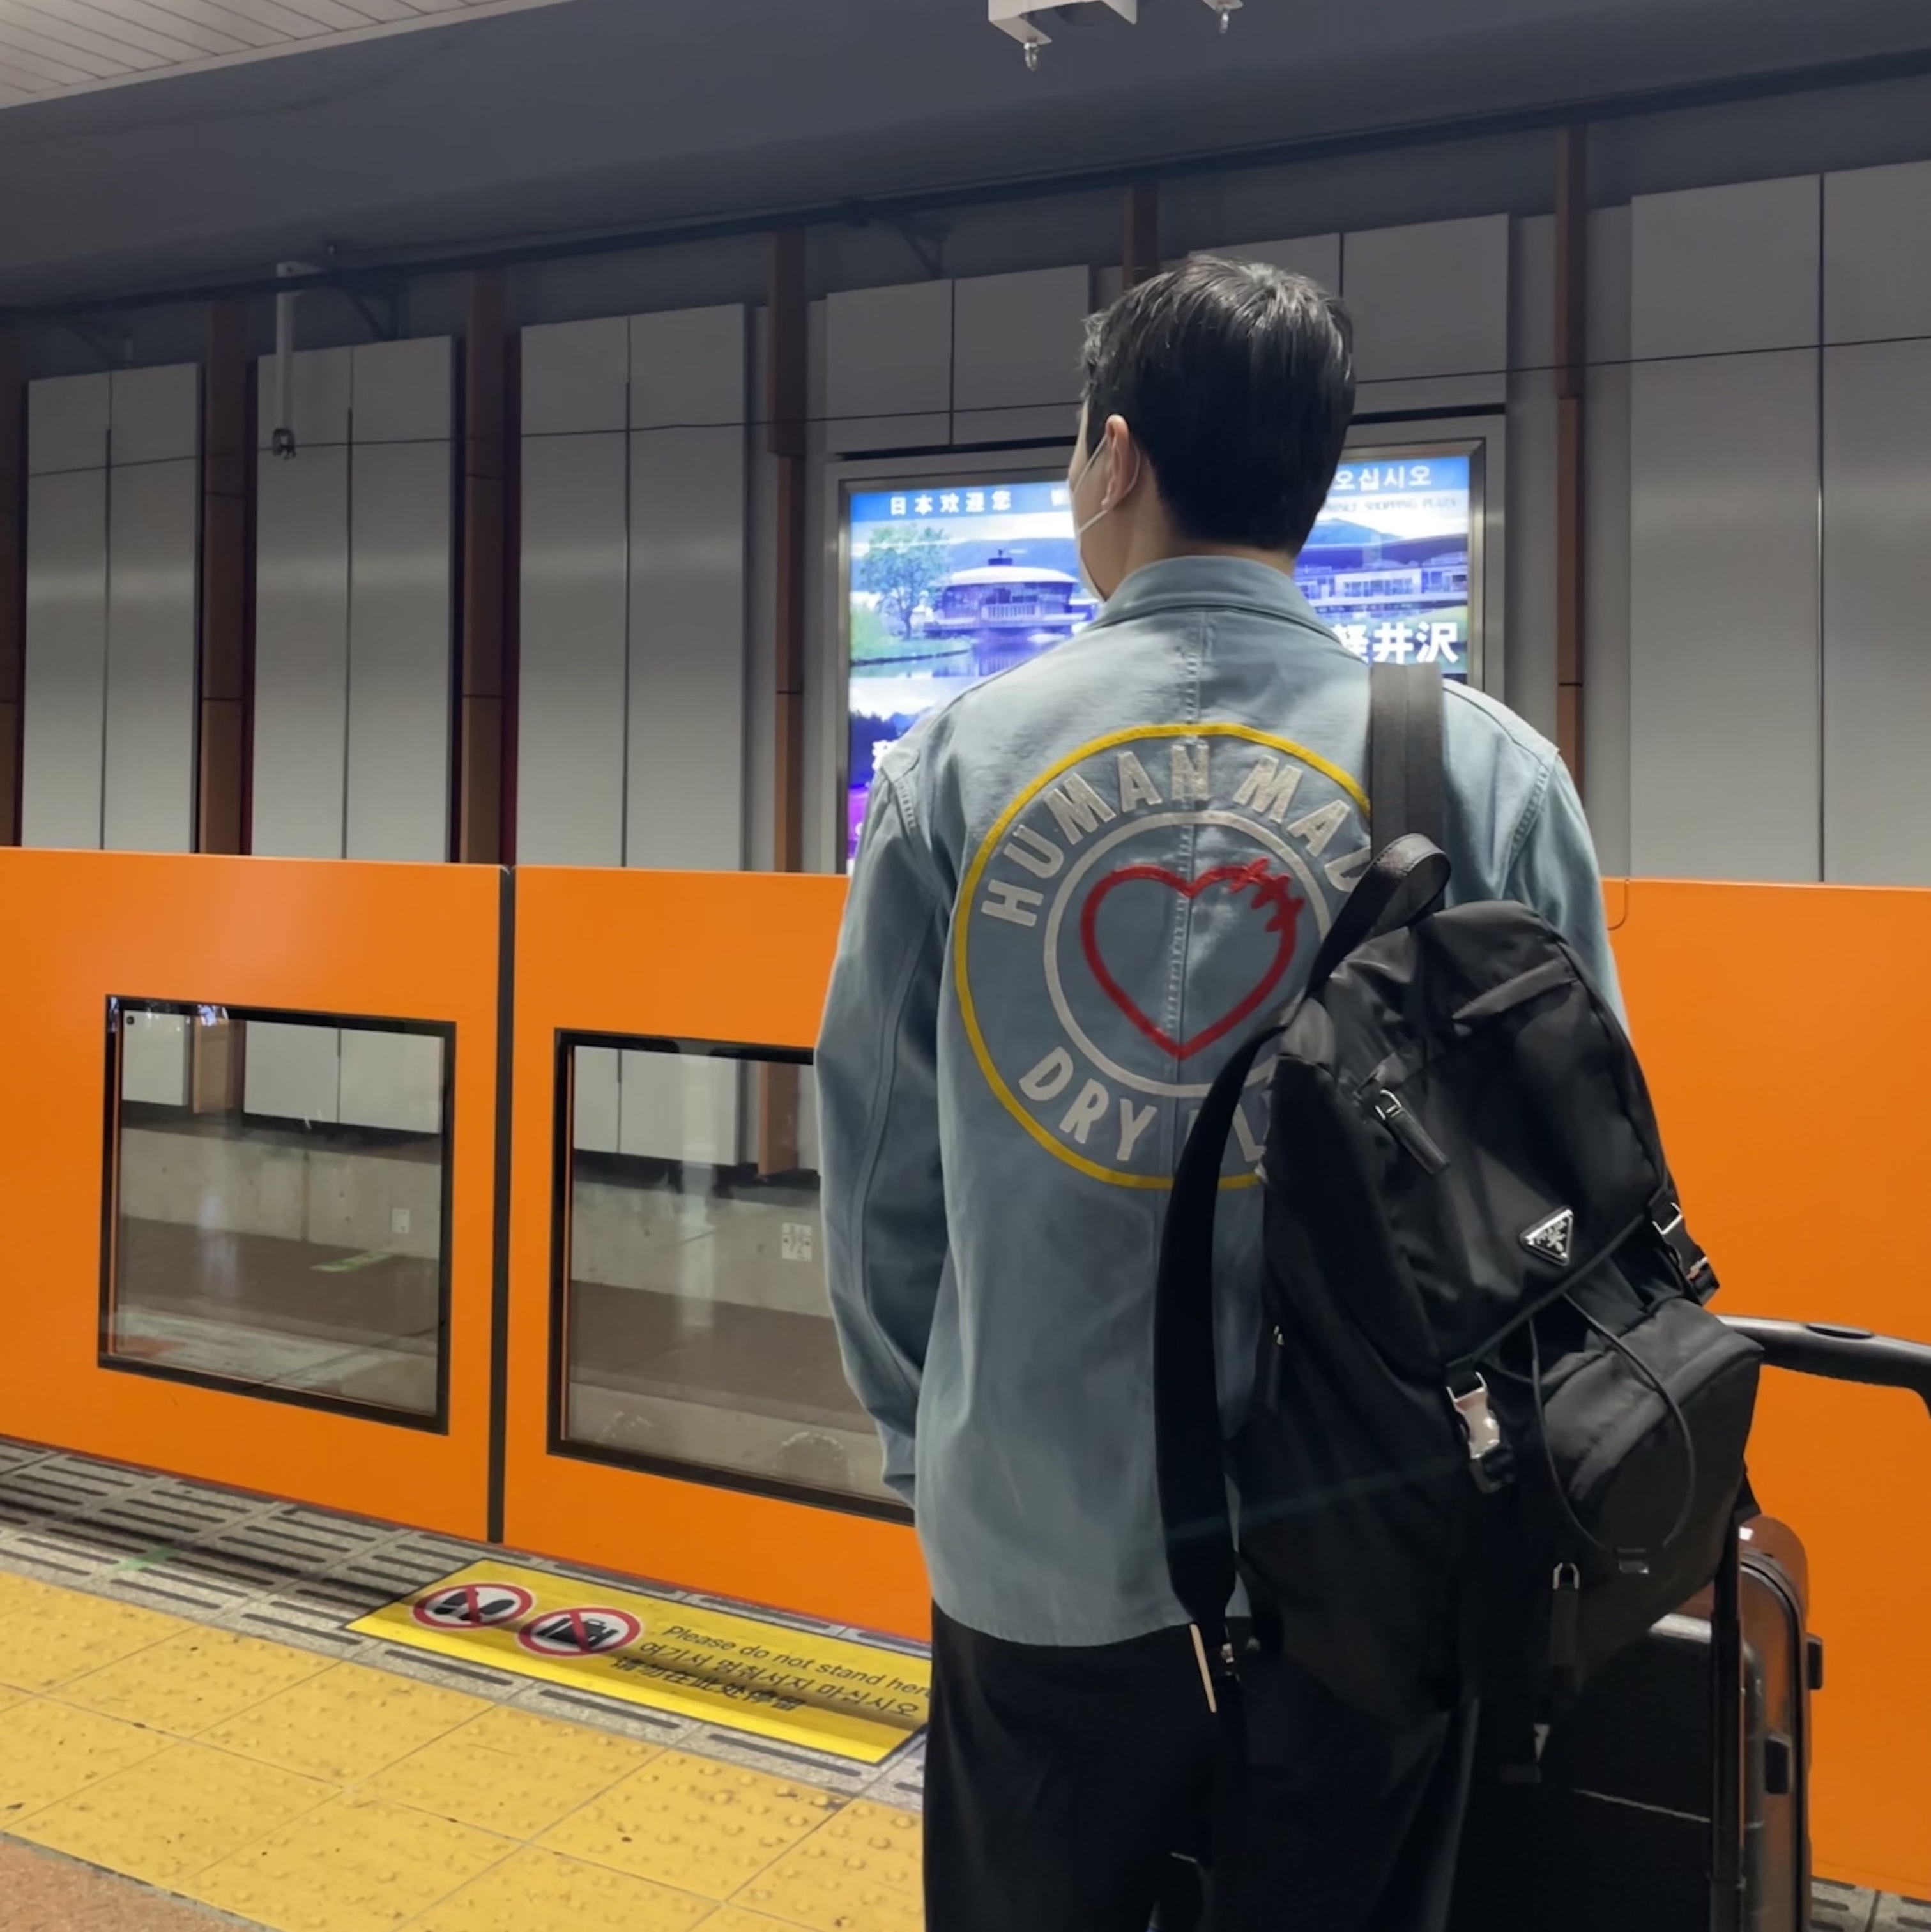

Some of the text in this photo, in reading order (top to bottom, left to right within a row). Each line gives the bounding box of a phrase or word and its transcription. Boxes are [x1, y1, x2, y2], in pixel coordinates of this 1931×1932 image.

[1333, 465, 1431, 491] 오십시오
[981, 740, 1371, 927] HUMAN MAD
[1018, 1047, 1157, 1160] DRY
[640, 1642, 713, 1667] 여기서
[816, 1683, 919, 1716] 마십시오
[662, 1625, 737, 1650] Please
[739, 1645, 770, 1659] do
[773, 1654, 816, 1669] not
[815, 1662, 886, 1685] stand
